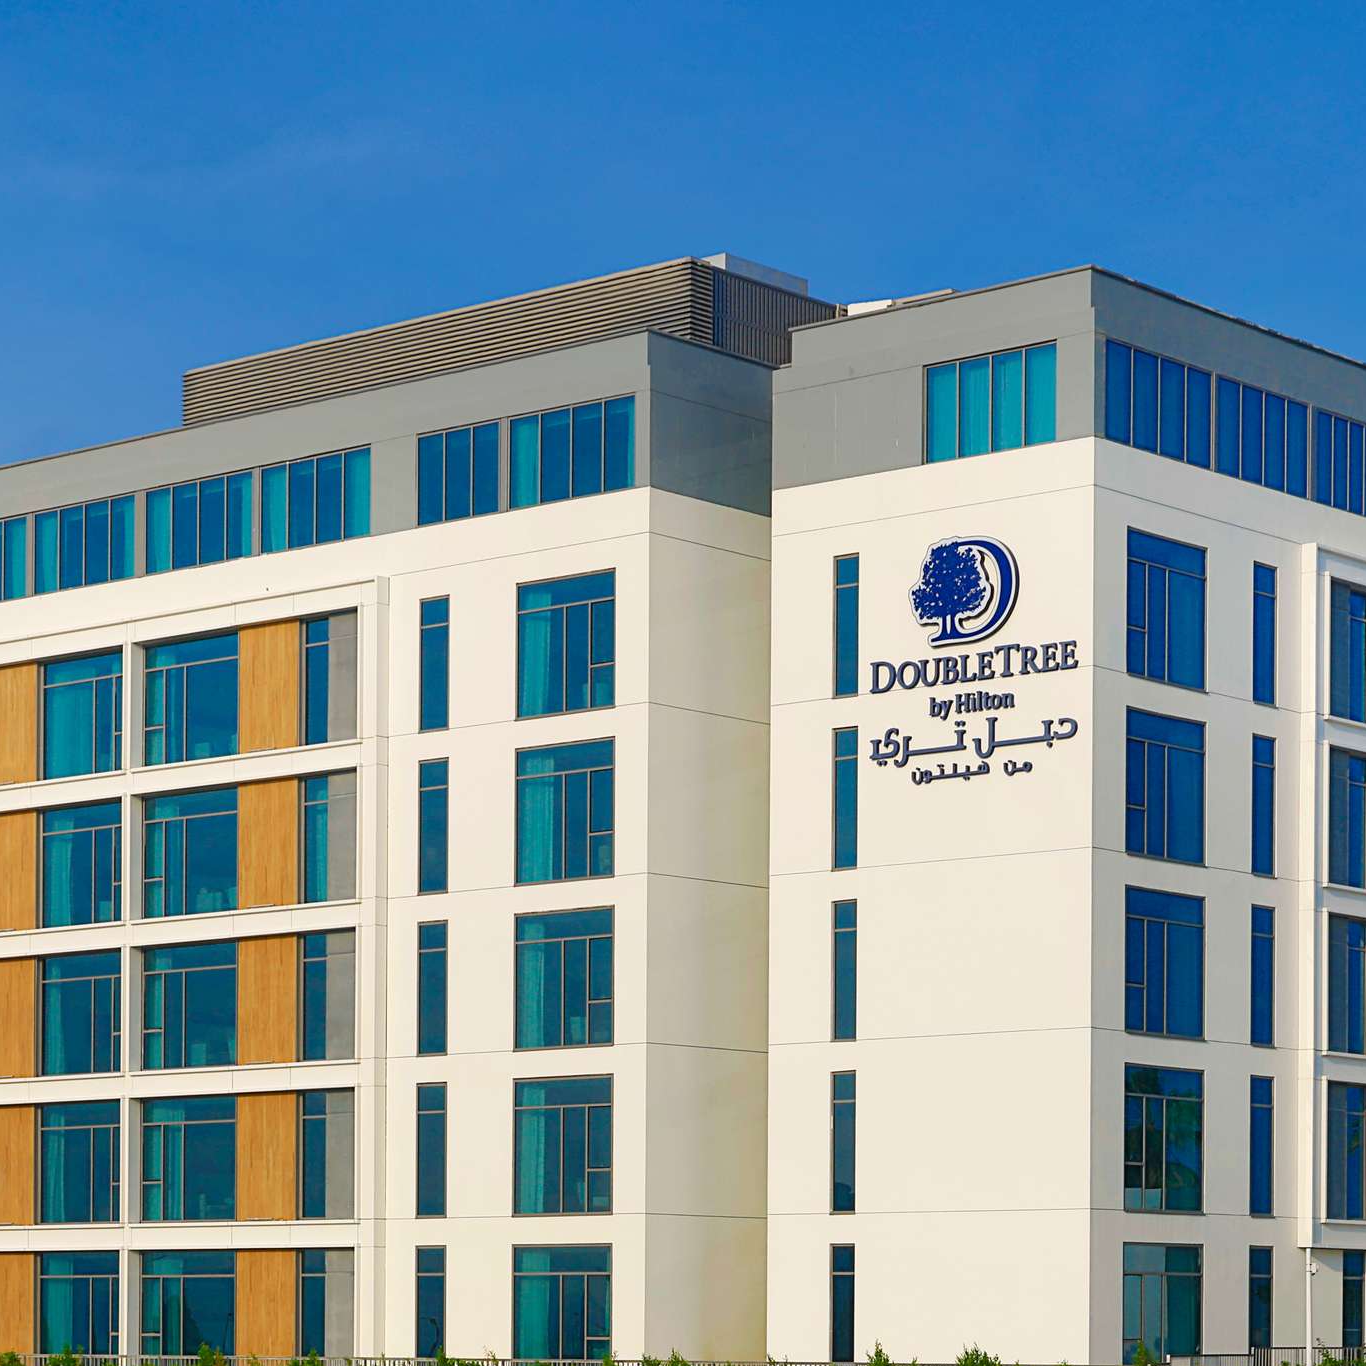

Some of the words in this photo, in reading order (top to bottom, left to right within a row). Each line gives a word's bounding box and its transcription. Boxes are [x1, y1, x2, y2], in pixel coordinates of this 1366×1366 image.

[869, 640, 1080, 694] DOUBLETREE
[928, 697, 953, 720] by
[955, 691, 1015, 714] Hilton
[1003, 760, 1033, 777] من
